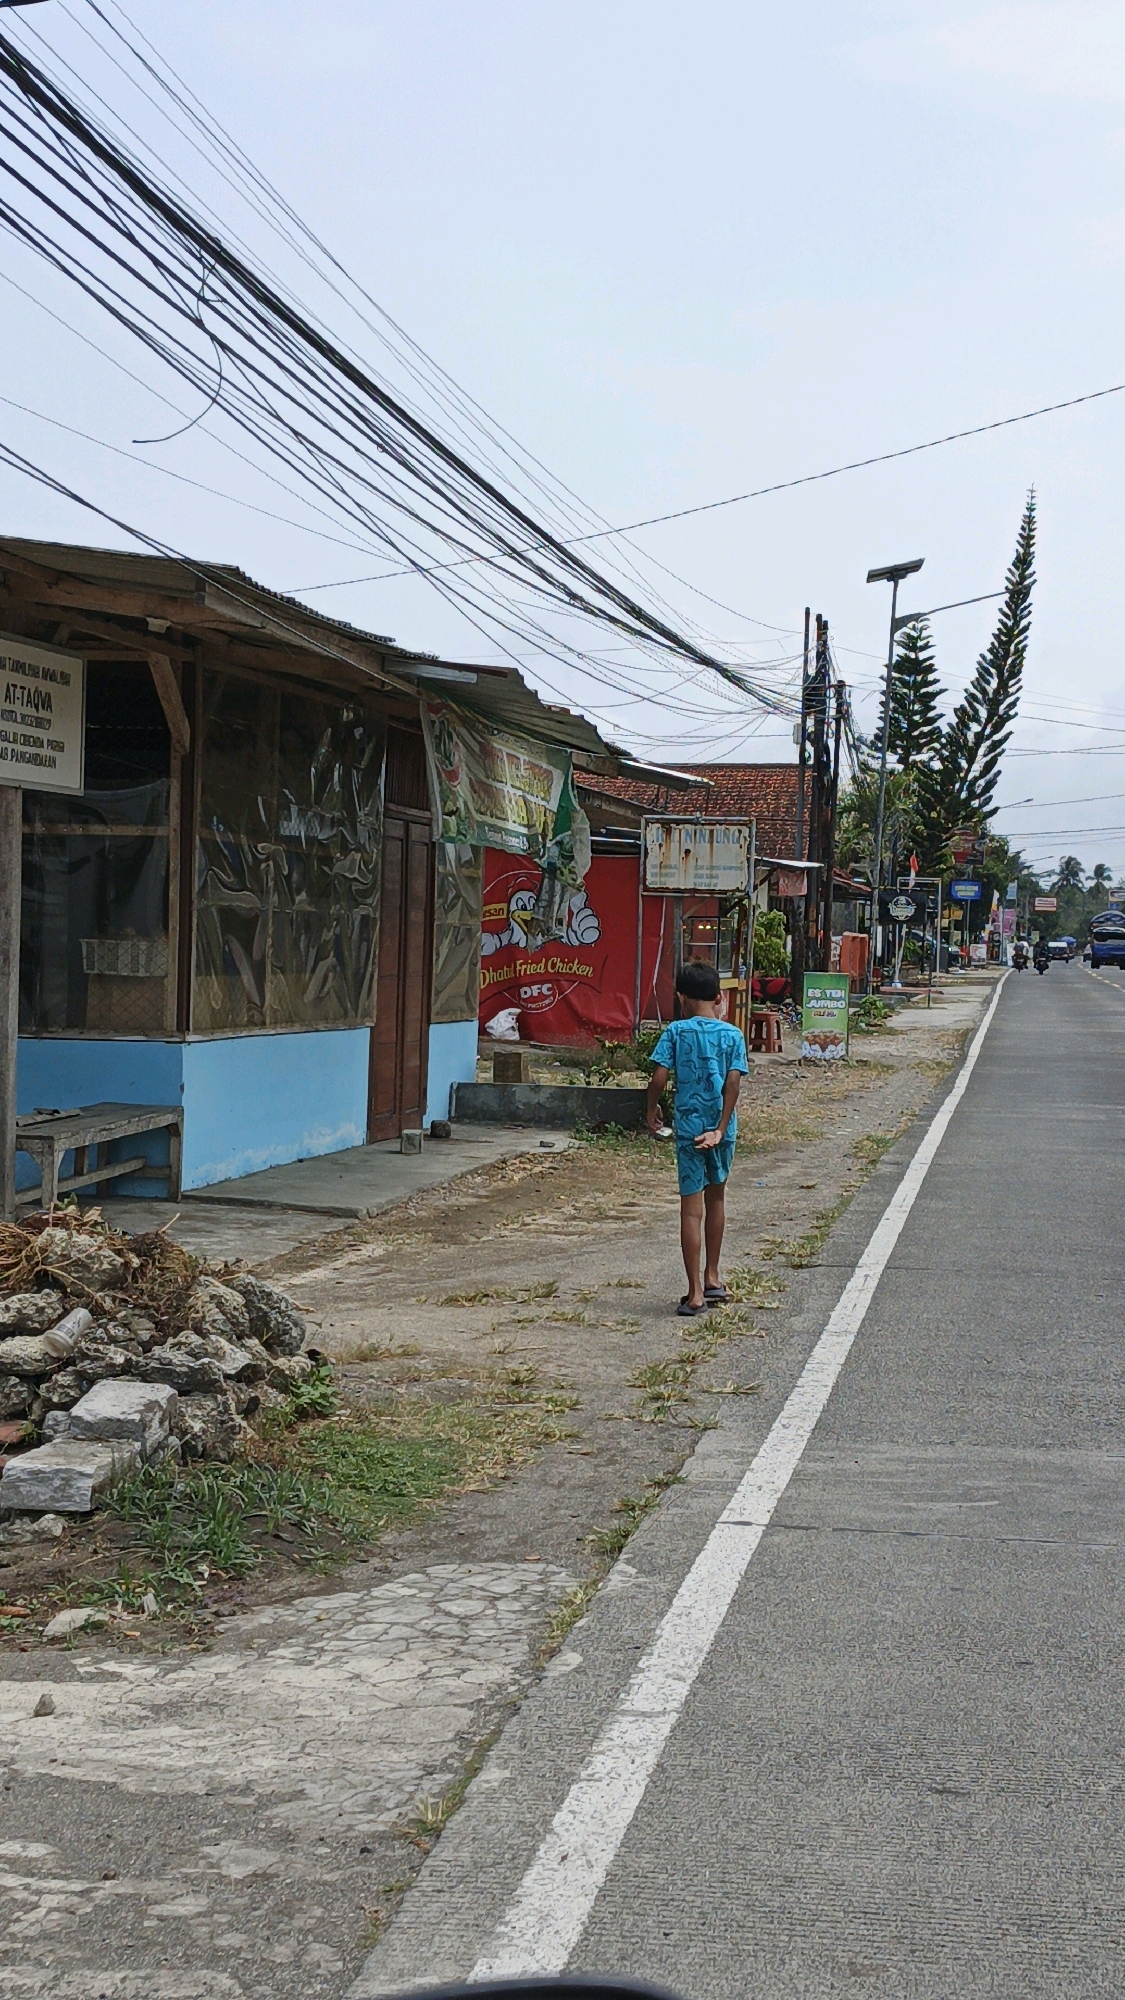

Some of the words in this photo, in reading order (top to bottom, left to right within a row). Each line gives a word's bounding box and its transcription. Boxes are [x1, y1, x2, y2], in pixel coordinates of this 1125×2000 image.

[516, 958, 546, 977] Fried
[547, 957, 594, 978] Chicken
[520, 983, 553, 998] DFC
[805, 1000, 846, 1009] JUMBO
